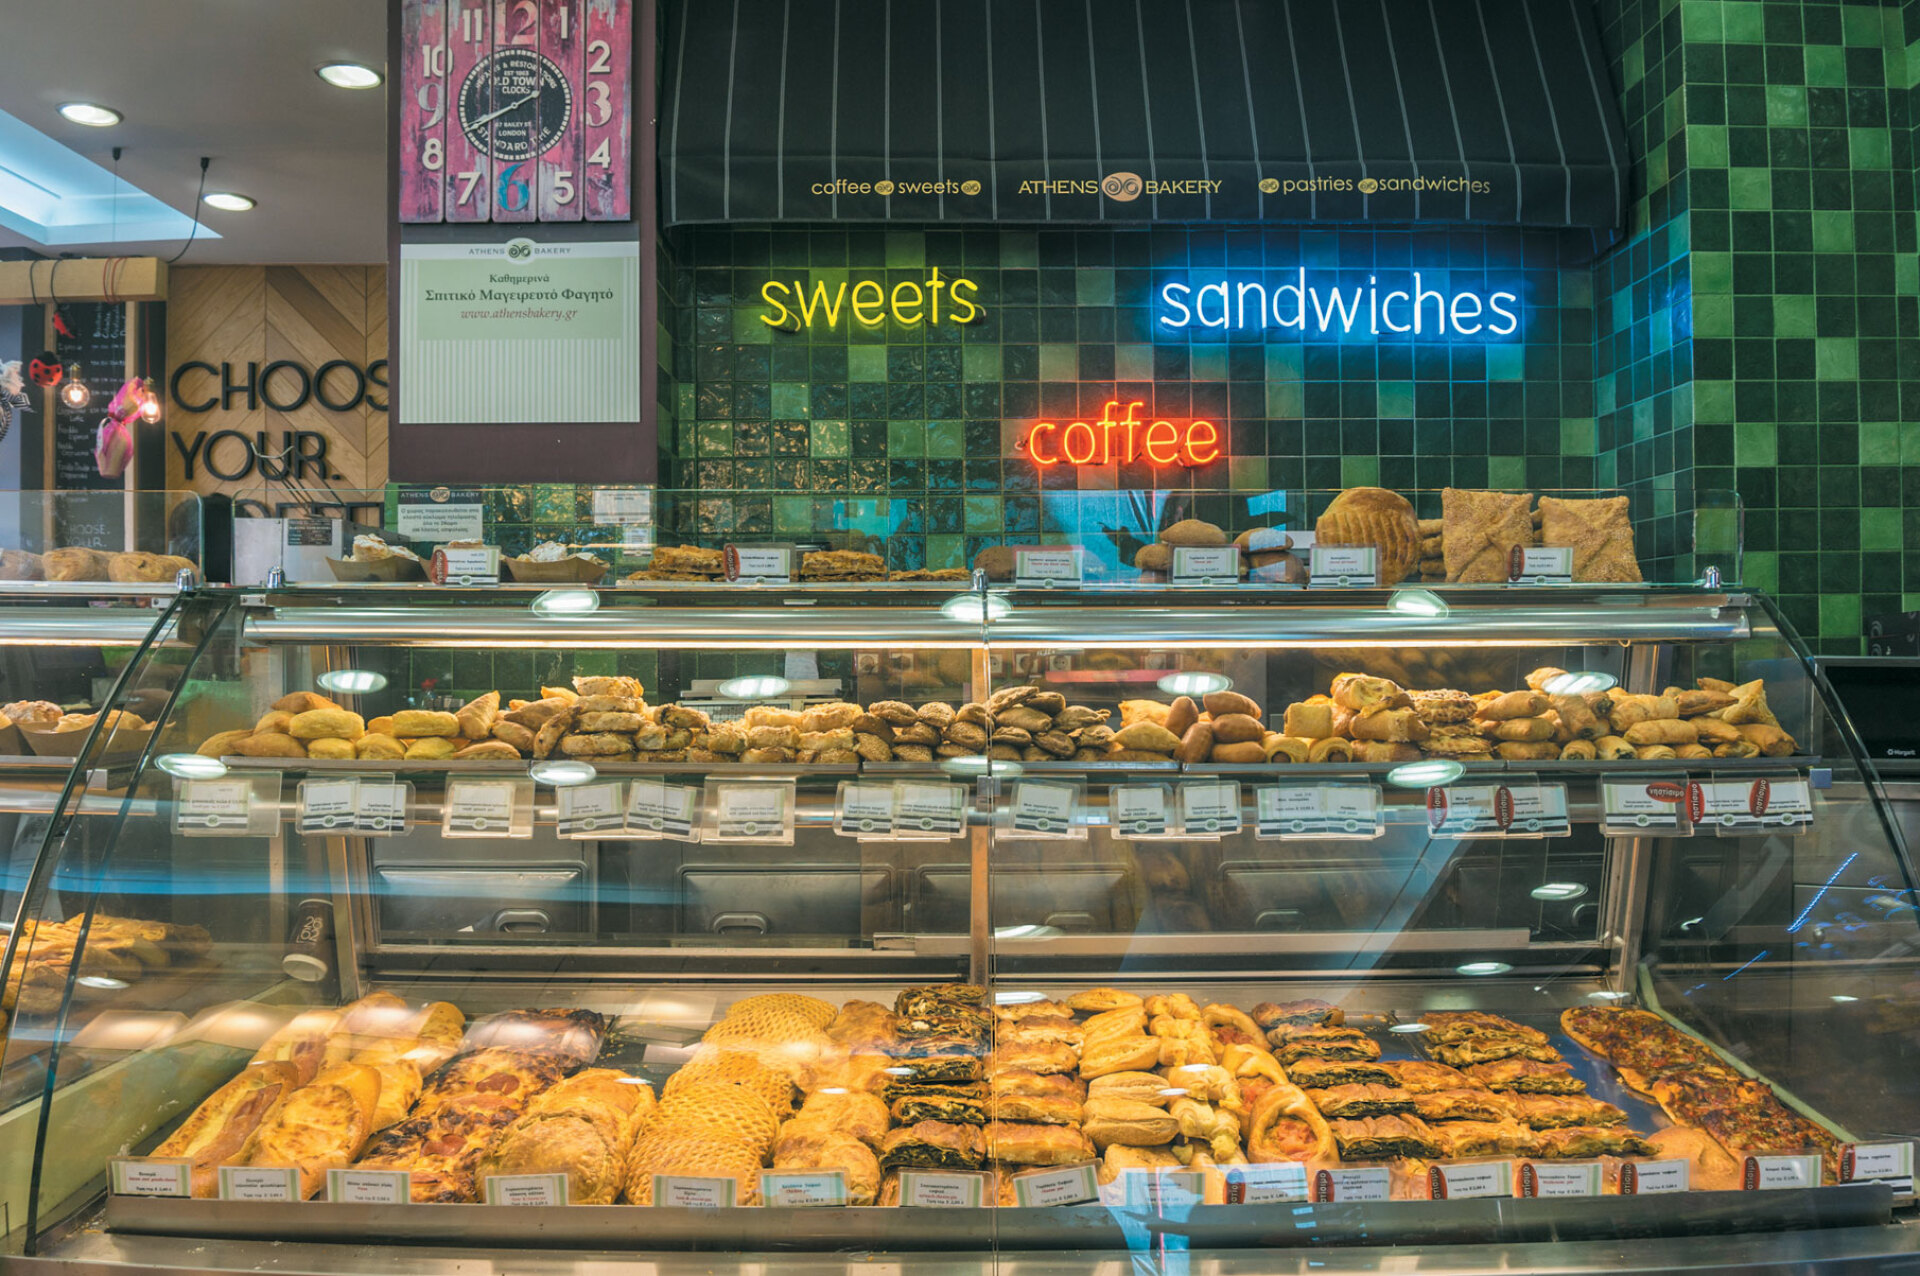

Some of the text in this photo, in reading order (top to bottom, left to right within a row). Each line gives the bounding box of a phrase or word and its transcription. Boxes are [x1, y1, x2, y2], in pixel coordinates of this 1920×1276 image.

[463, 8, 482, 42] 11
[495, 0, 538, 45] 12
[559, 6, 569, 39] 1
[422, 44, 453, 77] 10
[588, 40, 611, 73] 2
[418, 83, 444, 129] 9
[581, 81, 612, 126] 3
[422, 138, 444, 170] 8
[588, 137, 611, 168] 4
[458, 171, 482, 205] 7
[498, 162, 530, 211] 6
[553, 171, 575, 204] 5
[811, 178, 959, 195] coffee sweets
[1018, 180, 1221, 194] ATHENS BAKERY
[1283, 176, 1490, 195] pastries sandwiches
[425, 287, 613, 304] Σπιτικό Μαγειρευτό Φαγητό
[489, 274, 550, 284] Καθημερινά
[759, 266, 980, 328] sweets
[1159, 266, 1518, 336] sandwiches
[461, 307, 578, 321] www.athensbakery.gr
[1029, 401, 1219, 466] coffee
[171, 429, 341, 482] YOUR.
[1649, 787, 1685, 797] νηστίσιμο
[1691, 784, 1699, 820] νηστίσιμο
